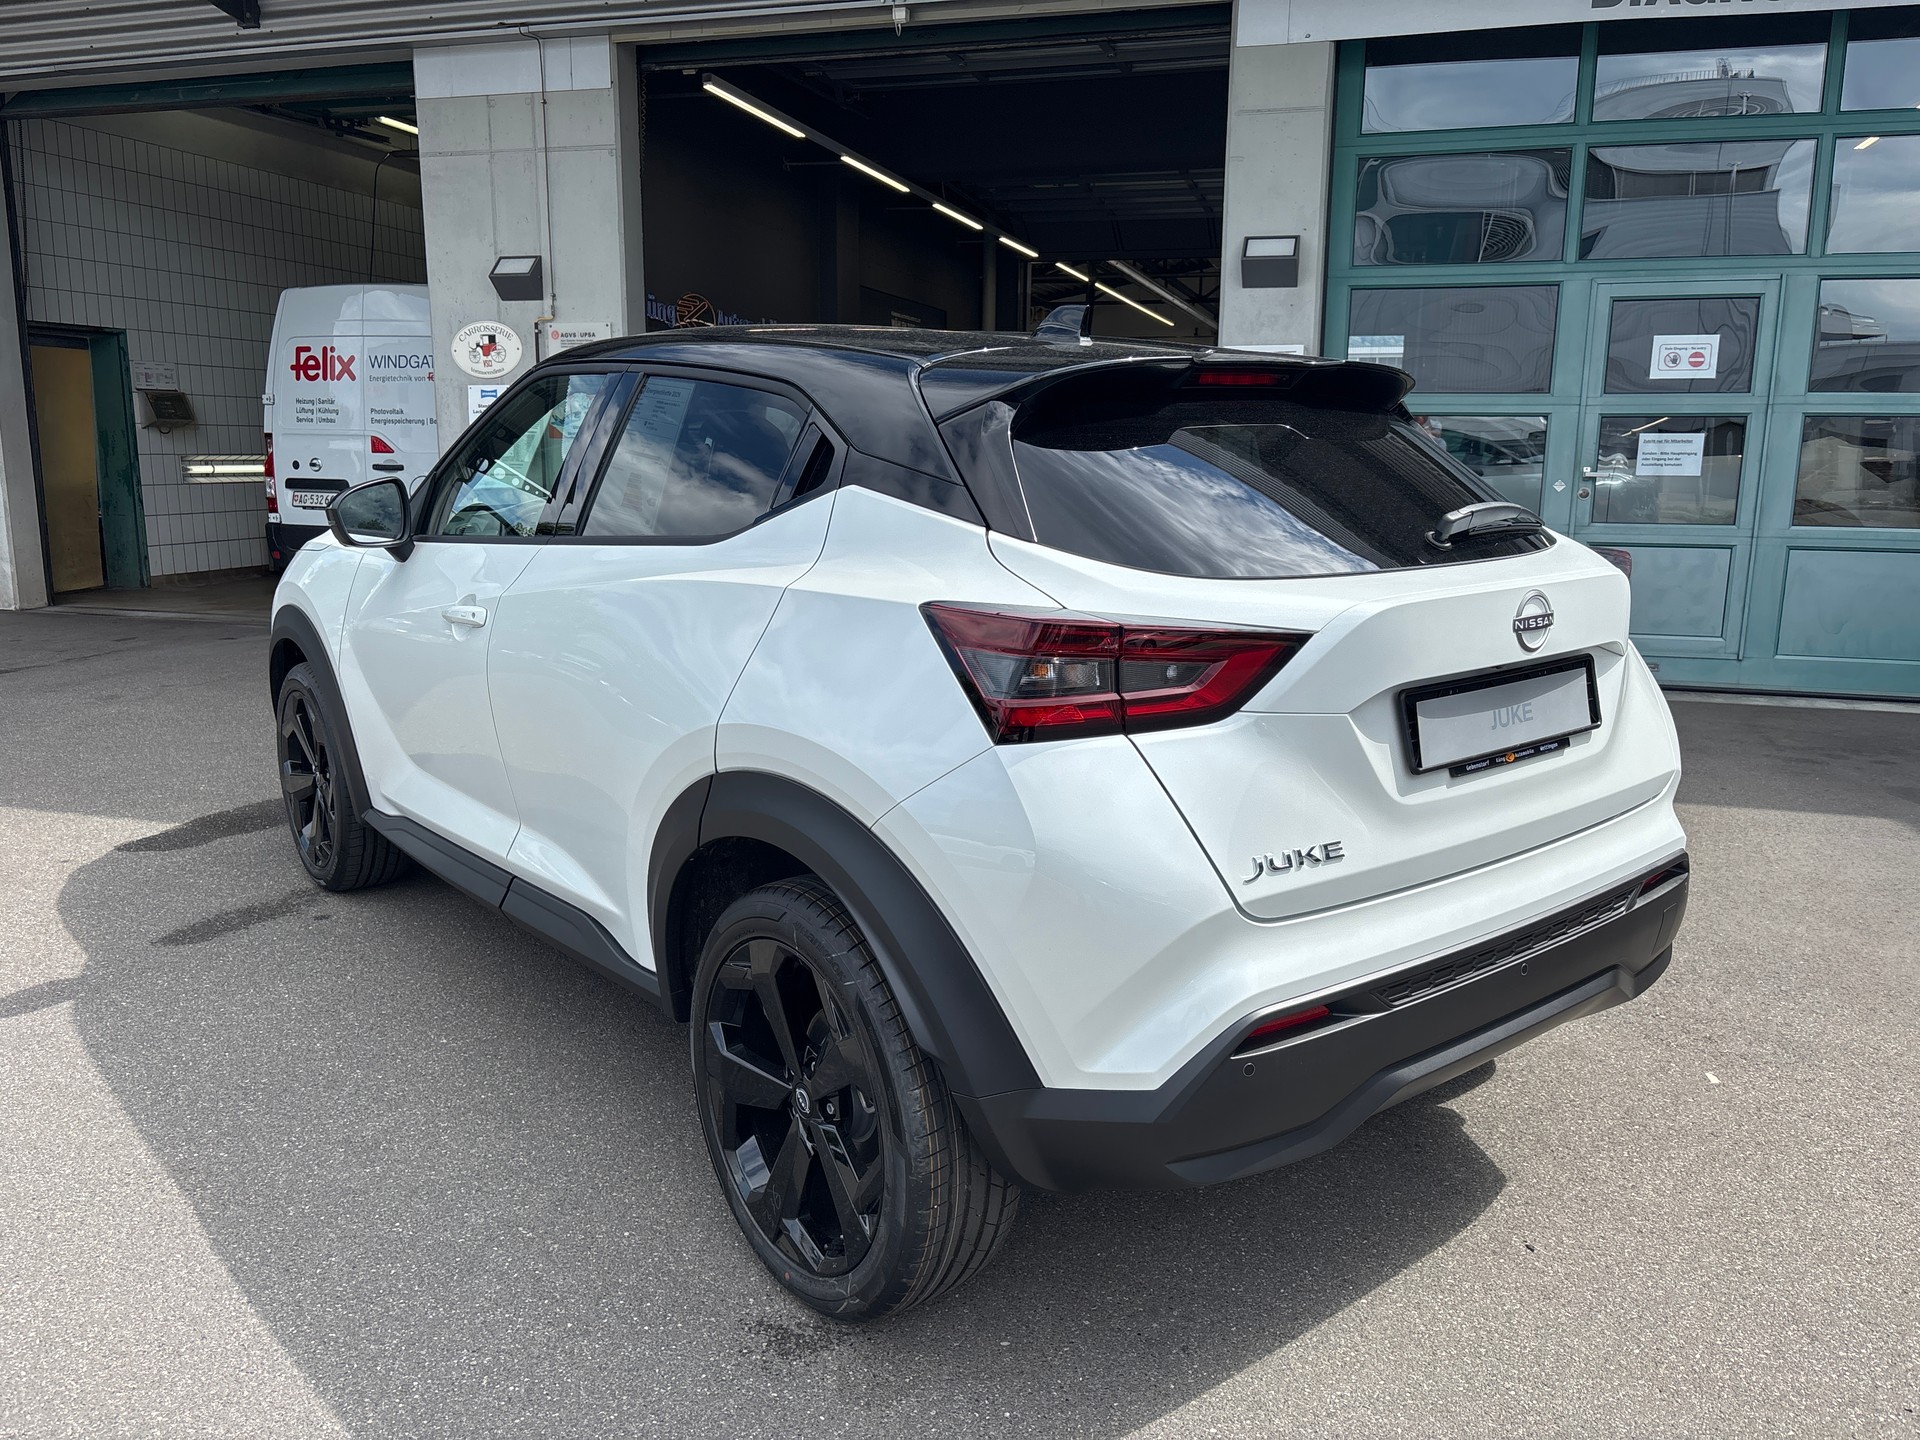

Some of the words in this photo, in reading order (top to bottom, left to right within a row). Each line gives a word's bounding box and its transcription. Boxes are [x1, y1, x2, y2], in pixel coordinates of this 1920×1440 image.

[458, 325, 513, 342] CARROSSERIE
[369, 375, 412, 383] Energietechnik
[296, 398, 315, 406] Heizung
[296, 407, 315, 415] Lüftung
[318, 407, 339, 416] Kühlung
[371, 418, 425, 426] Energiespeicherung
[1515, 615, 1554, 630] NISSAN
[1491, 702, 1534, 730] JUKE
[1466, 760, 1489, 771] Gebenstorf
[1515, 748, 1534, 758] Automobile
[1242, 840, 1345, 885] JUKE
